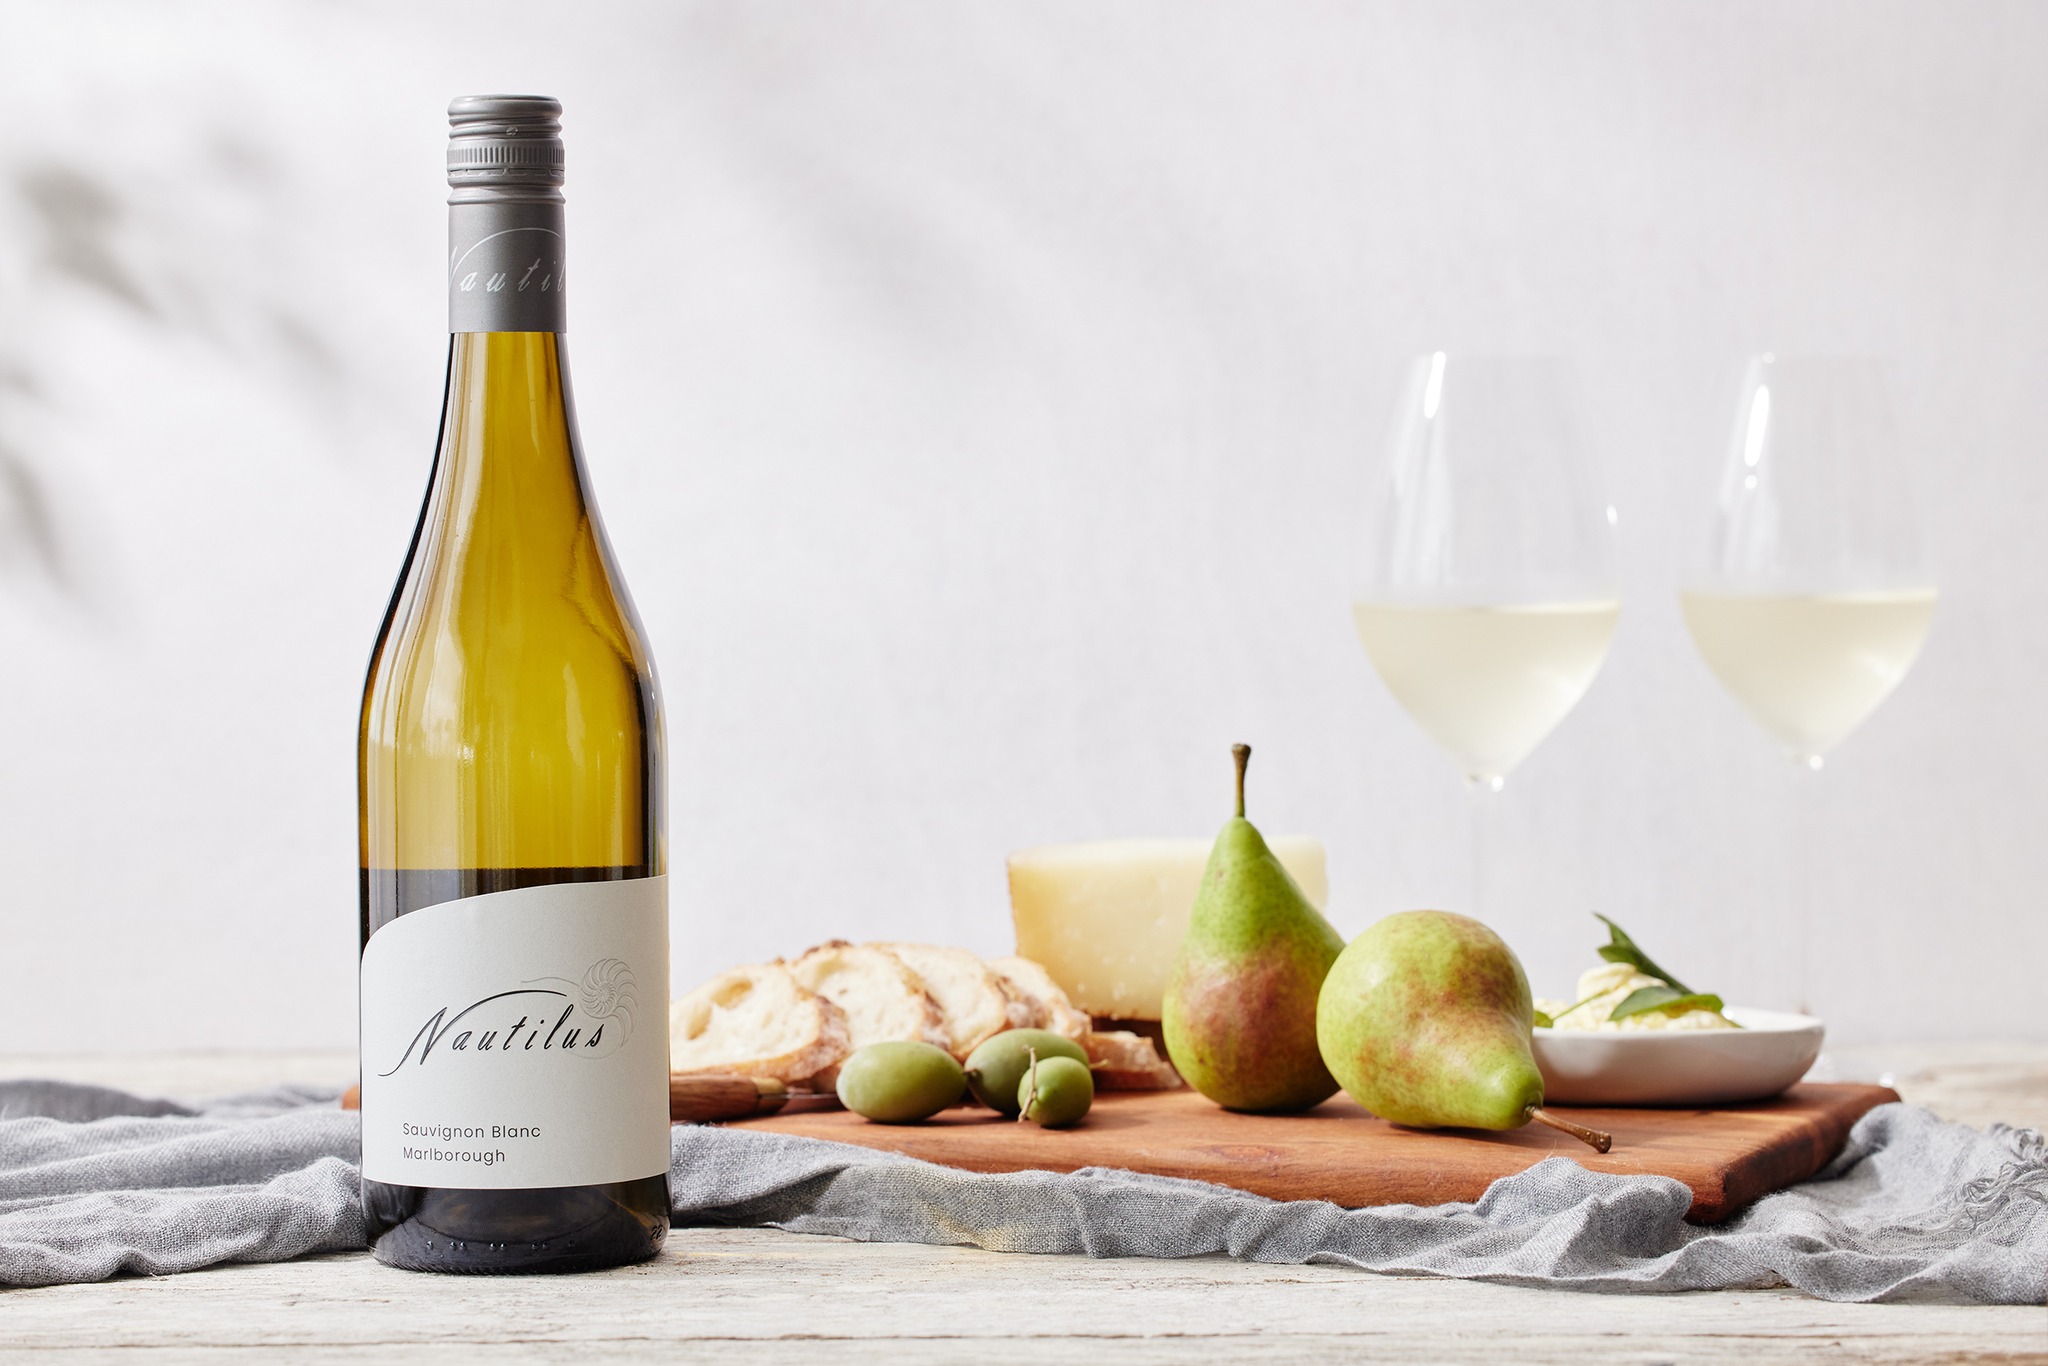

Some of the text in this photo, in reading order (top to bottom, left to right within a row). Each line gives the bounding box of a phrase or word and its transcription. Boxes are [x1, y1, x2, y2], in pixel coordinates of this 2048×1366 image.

[378, 989, 605, 1077] Nautilus
[402, 1122, 542, 1142] Sauvignon Blanc
[402, 1146, 506, 1167] Marlborough
